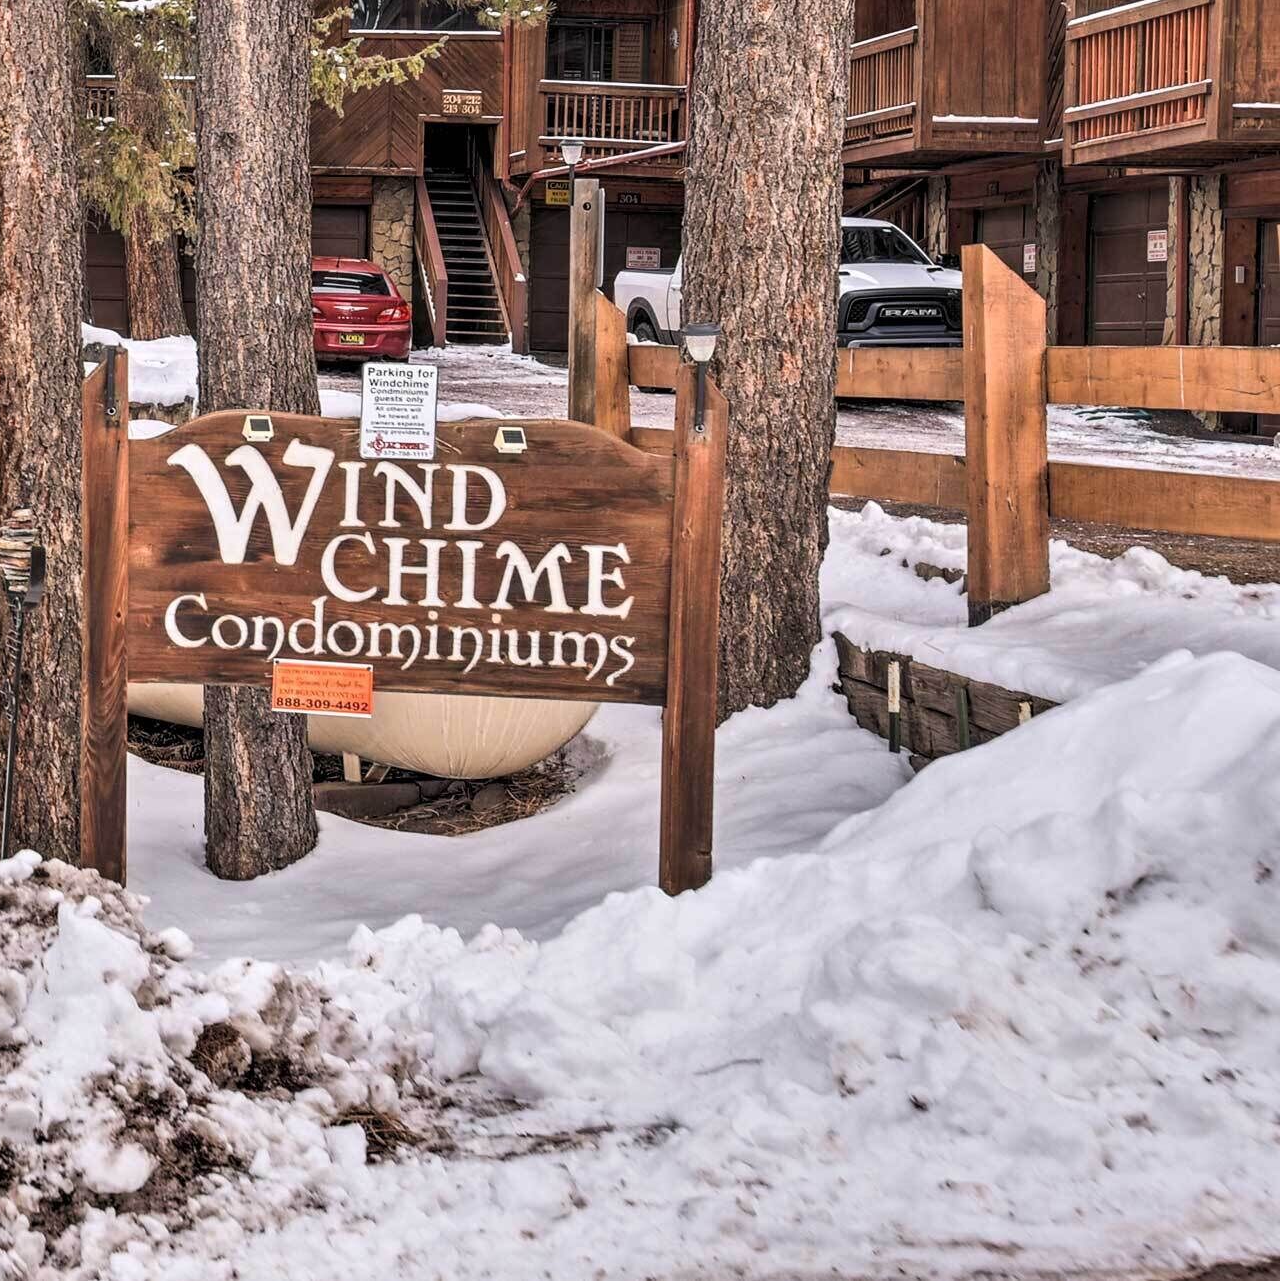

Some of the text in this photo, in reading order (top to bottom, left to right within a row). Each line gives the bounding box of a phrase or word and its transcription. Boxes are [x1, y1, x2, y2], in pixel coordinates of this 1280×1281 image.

[443, 95, 461, 104] 204
[549, 181, 569, 189] CAUT
[367, 367, 434, 379] Parking for
[369, 379, 430, 388] Windchime
[166, 438, 508, 567] WIND
[321, 531, 636, 620] CHIME
[163, 592, 637, 687] Condominiums
[276, 697, 369, 711] 888-309-4492
